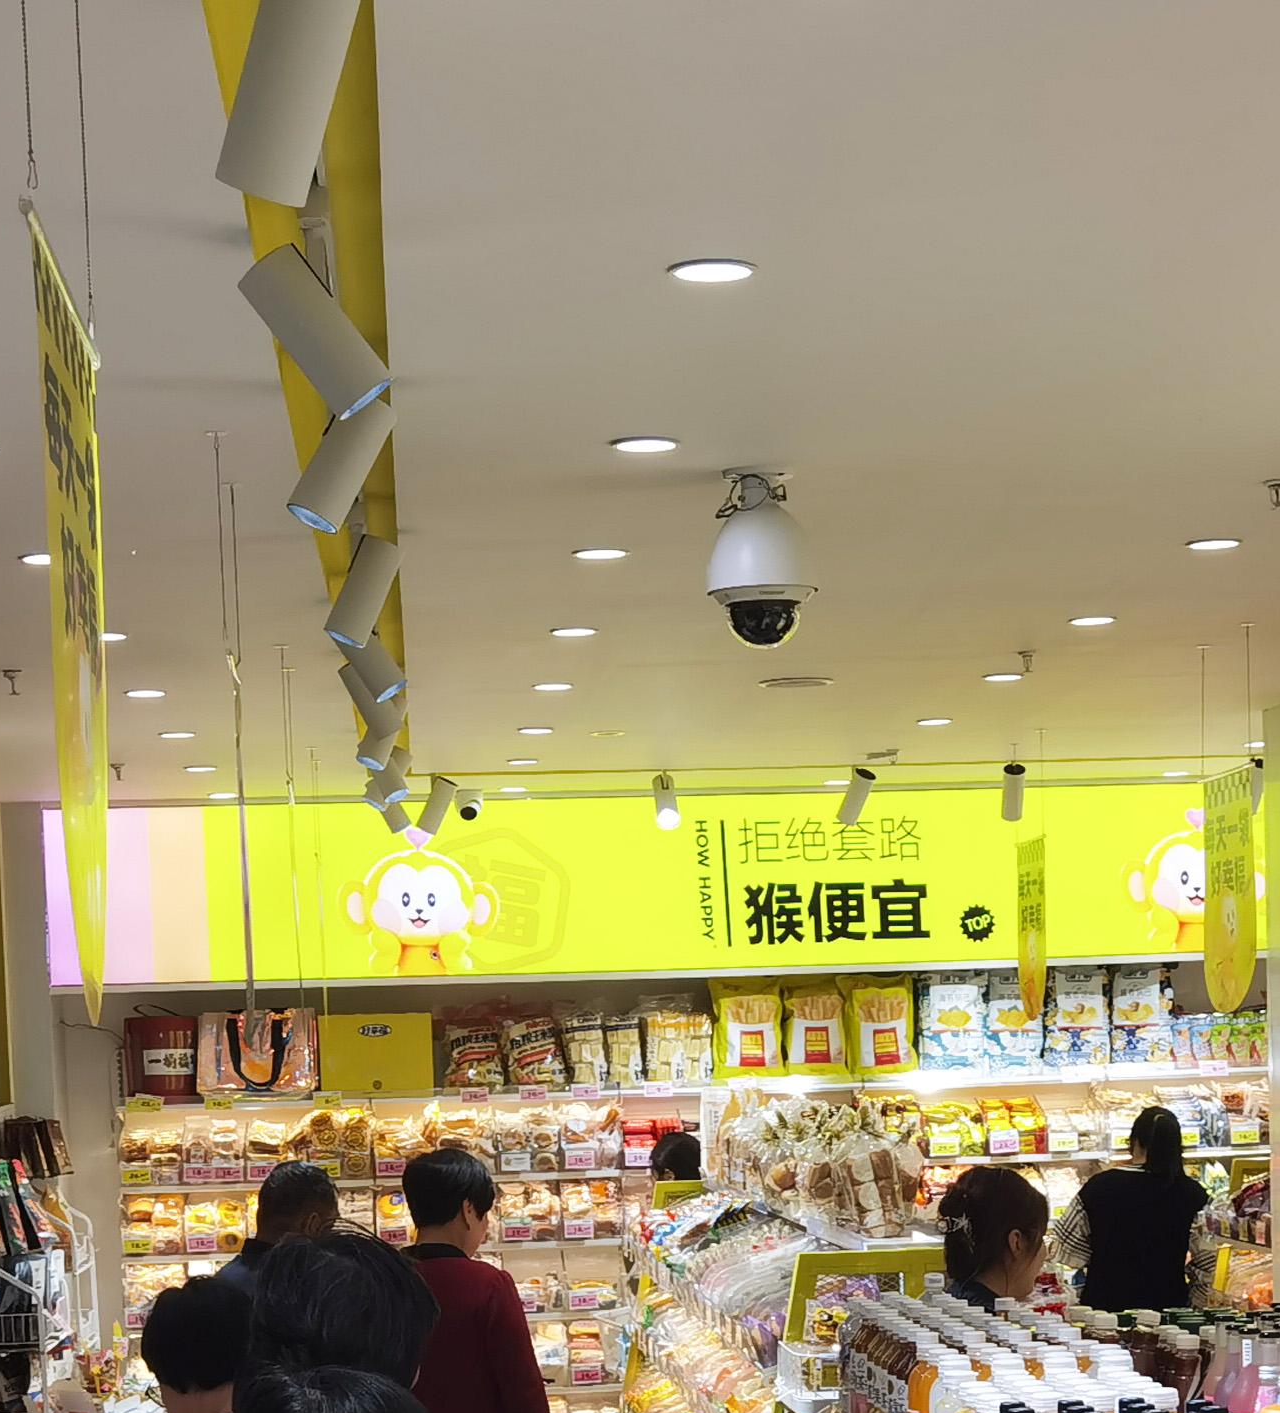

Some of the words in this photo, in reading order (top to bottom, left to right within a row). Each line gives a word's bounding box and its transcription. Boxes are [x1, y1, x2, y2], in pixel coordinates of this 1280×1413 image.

[695, 820, 711, 867] HOW
[738, 816, 922, 864] 拒绝套路
[698, 877, 715, 940] HAPPY
[744, 879, 931, 945] 猴便宜
[964, 913, 992, 933] TOP
